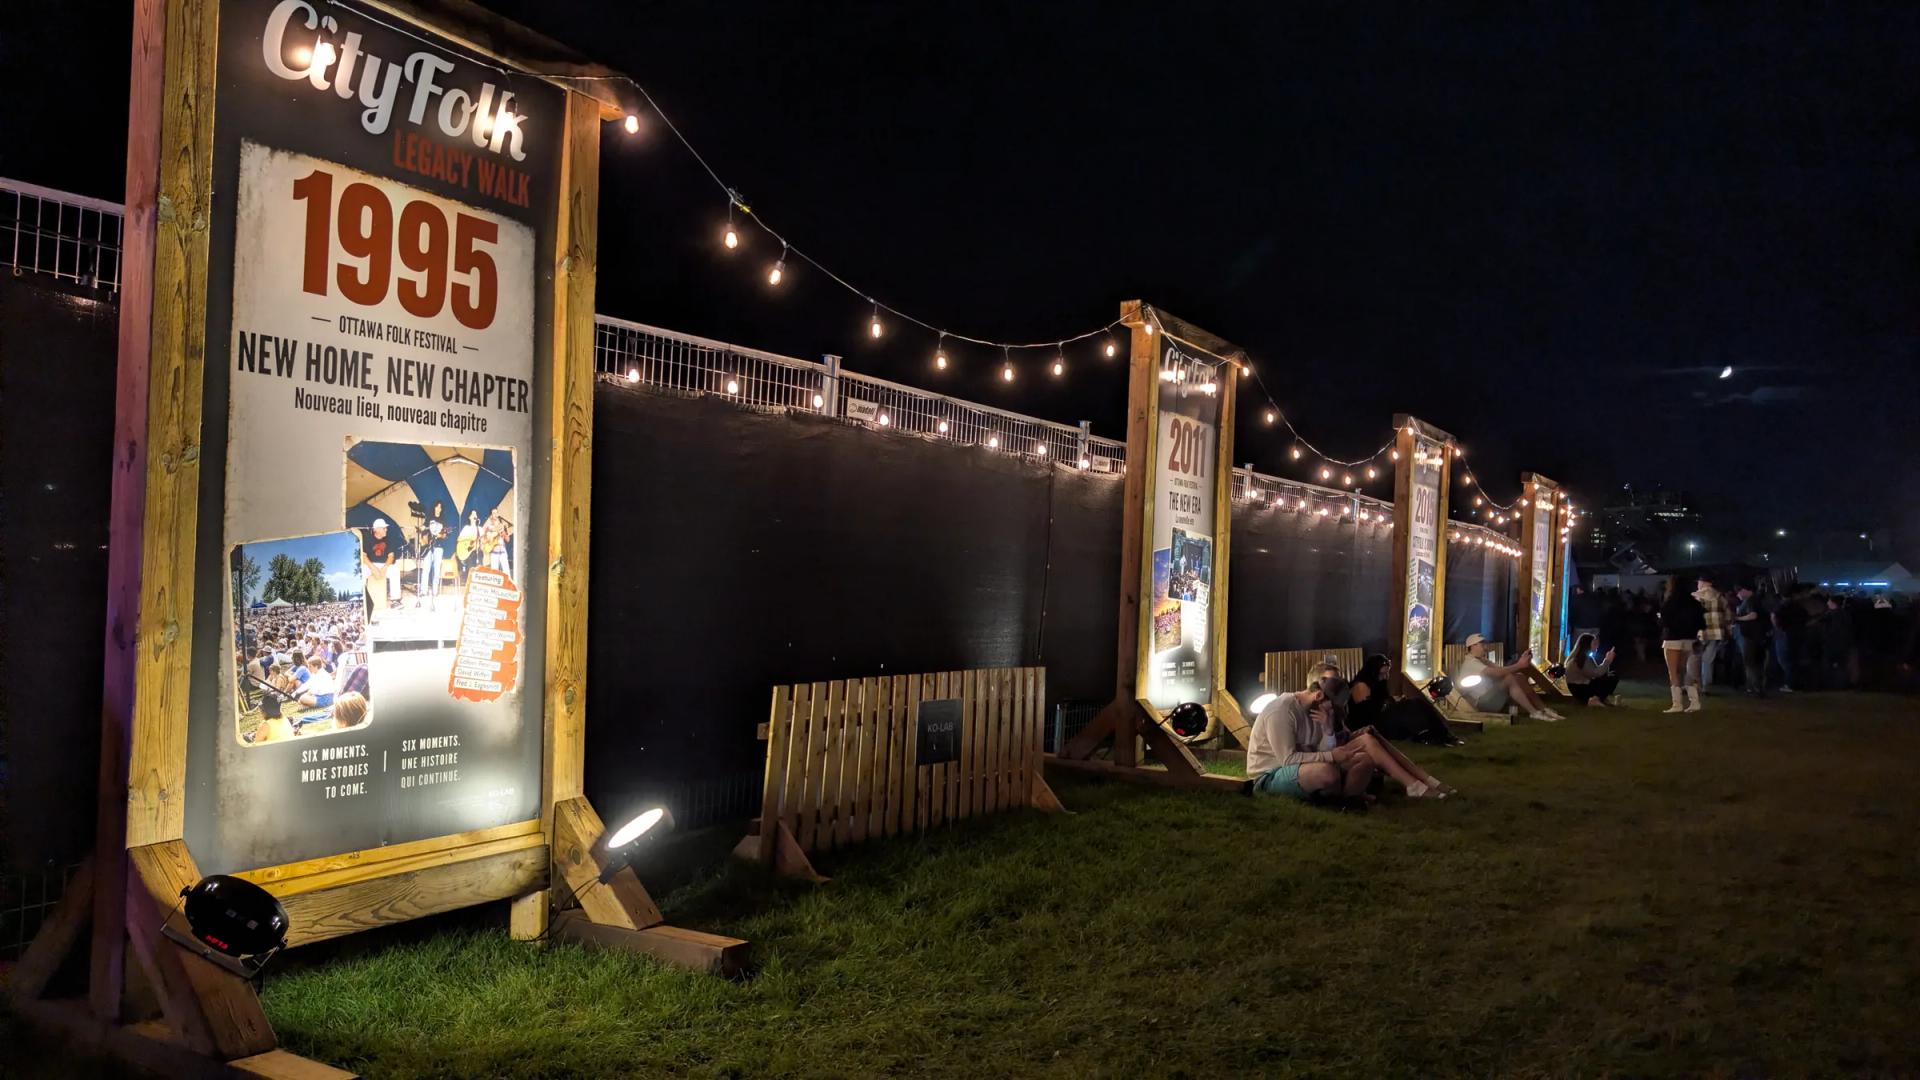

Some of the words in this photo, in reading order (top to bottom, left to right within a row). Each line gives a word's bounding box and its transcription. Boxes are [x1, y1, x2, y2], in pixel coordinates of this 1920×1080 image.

[393, 128, 474, 190] LEGACY
[477, 159, 531, 209] WALK
[293, 169, 499, 330] 1995
[338, 315, 384, 341] OTTAWA
[386, 324, 412, 346] FOLK
[414, 331, 458, 354] FESTIVAL
[237, 330, 298, 379] NEW
[305, 342, 380, 397] HOME,
[387, 356, 436, 400] NEW
[441, 366, 530, 414] CHAPTER
[295, 386, 352, 416] Nouveau
[356, 394, 384, 422] lieu,
[387, 405, 437, 428] nouveau
[440, 408, 488, 434] chapitre
[1168, 418, 1207, 478] 2011
[1169, 491, 1179, 511] THE
[1179, 494, 1192, 513] NEW
[1192, 495, 1202, 515] ERA
[302, 749, 318, 763] SIX
[321, 744, 369, 762] MOMENTS.
[402, 739, 417, 752] SIX
[419, 735, 461, 750] MOMENTS.
[301, 768, 328, 783] MORE
[331, 763, 369, 779] STORIES
[401, 757, 418, 770] UNE
[421, 753, 458, 768] HISTOIRE
[325, 786, 338, 799] TO
[340, 783, 368, 797] COME.
[400, 776, 416, 789] QUI
[418, 771, 461, 787] CONTINUE.
